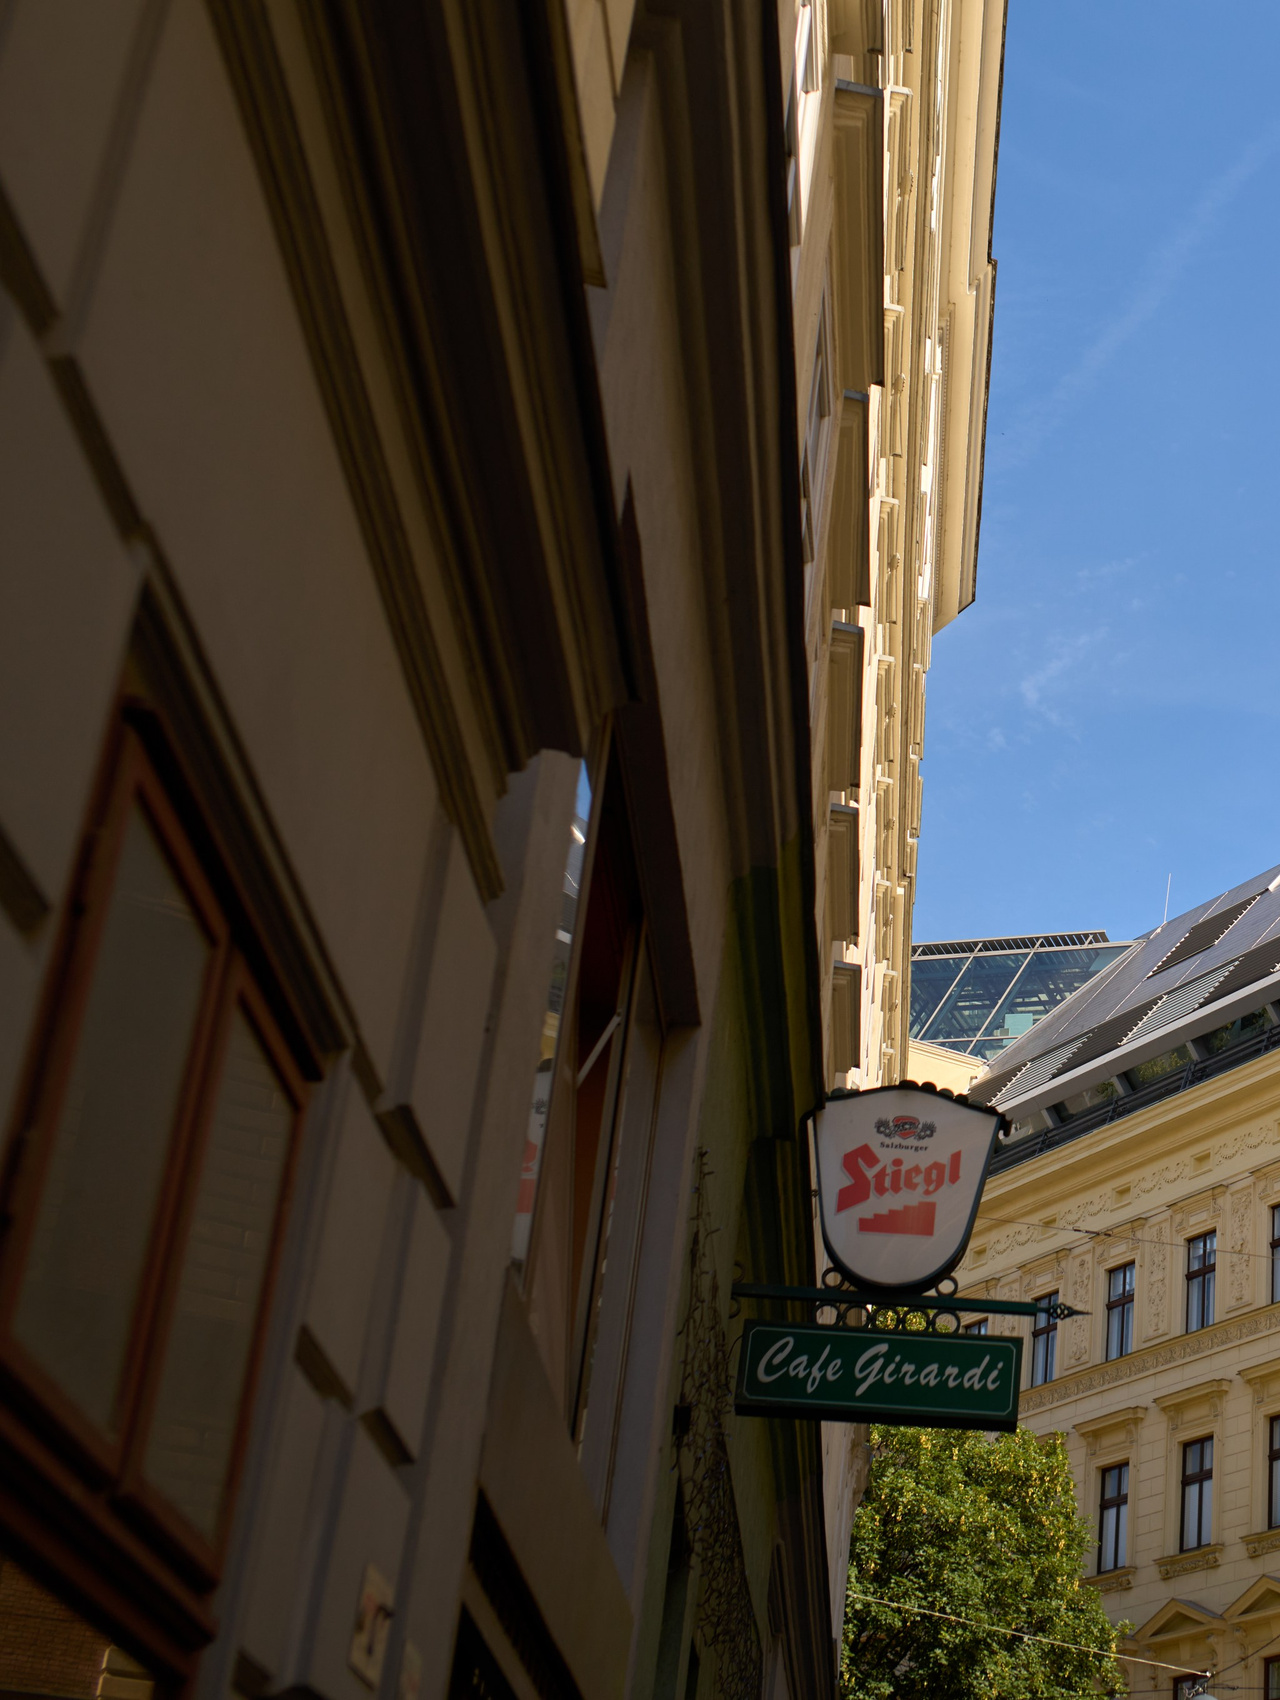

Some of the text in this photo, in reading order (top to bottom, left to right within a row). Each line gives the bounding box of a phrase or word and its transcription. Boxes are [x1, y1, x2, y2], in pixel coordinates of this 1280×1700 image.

[879, 1141, 929, 1152] Salzburger
[835, 1143, 961, 1214] Stiegl
[756, 1336, 1003, 1396] Cafe Girardi
